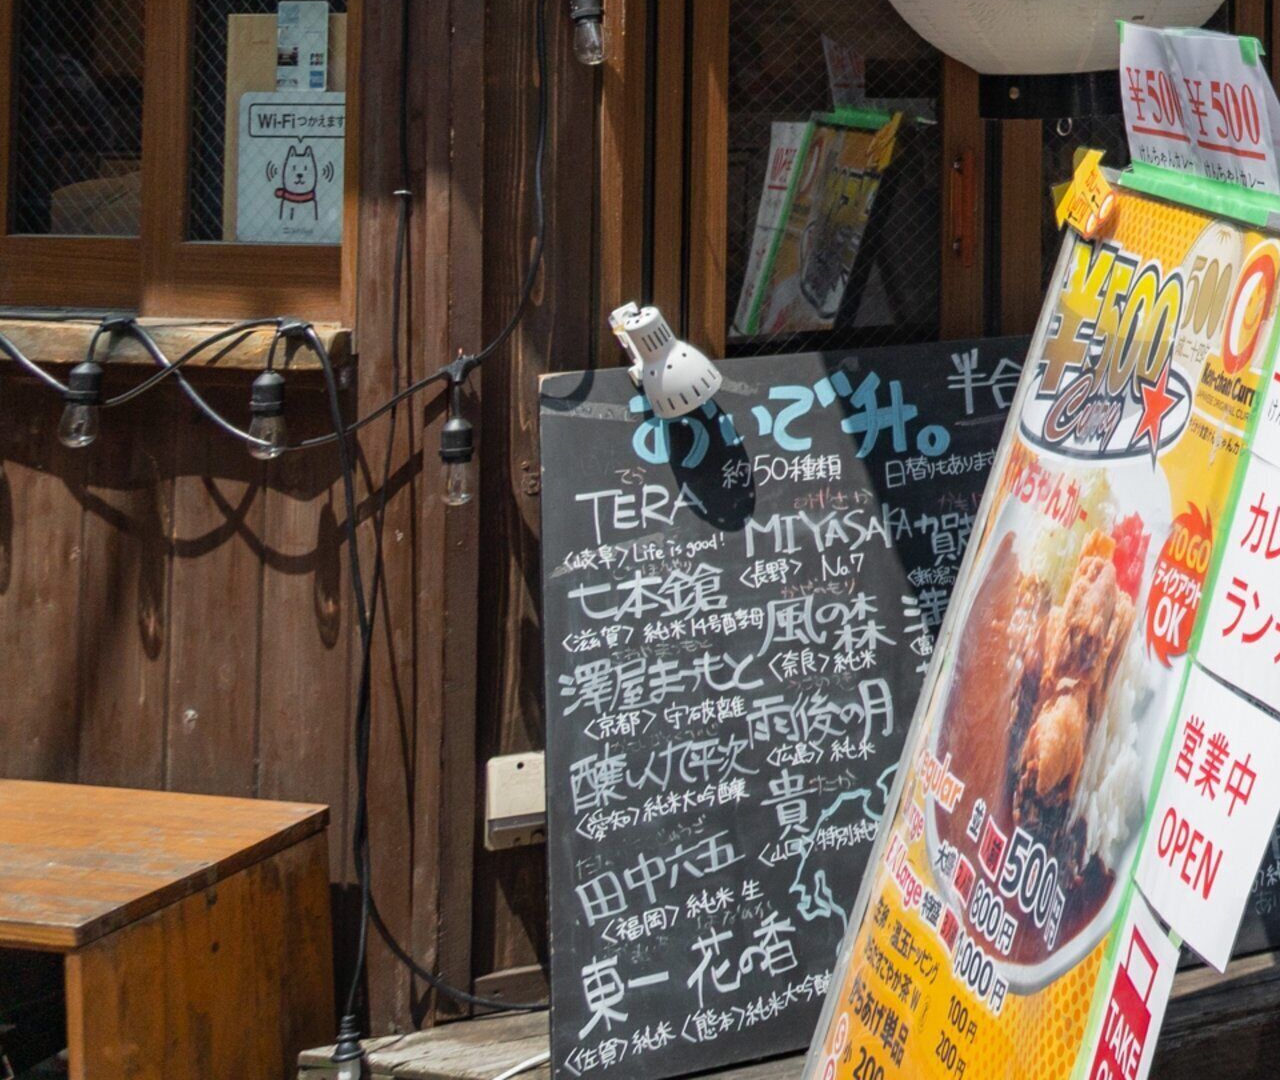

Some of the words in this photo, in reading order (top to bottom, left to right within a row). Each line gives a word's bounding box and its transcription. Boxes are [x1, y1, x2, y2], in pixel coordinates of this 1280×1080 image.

[1183, 78, 1261, 145] ¥500
[722, 453, 842, 488] 約50種類
[575, 481, 708, 545] TERA
[744, 502, 914, 558] MIYASAKA
[633, 541, 664, 563] Life
[666, 539, 683, 557] is
[686, 532, 726, 558] good!
[1185, 533, 1212, 574] GO
[1155, 560, 1202, 610] テイクアウト
[757, 592, 898, 657] 風の森
[1153, 596, 1187, 648] OK
[833, 648, 877, 675] 純米
[663, 695, 748, 730] 守破離
[746, 677, 894, 751] 雨後の月
[830, 737, 877, 763] 純米
[1174, 714, 1258, 819] 営業中
[642, 777, 750, 822] 純米大吟醸
[760, 769, 818, 841] 貴
[575, 830, 747, 927] 田中六五
[1156, 806, 1224, 901] OPEN
[686, 889, 735, 917] 純米
[741, 879, 765, 902] 生
[971, 880, 1018, 955] 800円
[1001, 828, 1065, 948] 500円
[687, 910, 797, 1008] 花の香
[578, 955, 670, 1041] 東一
[947, 994, 978, 1044] 100円
[631, 1020, 677, 1055] 純米
[1105, 998, 1141, 1080] TAKE
